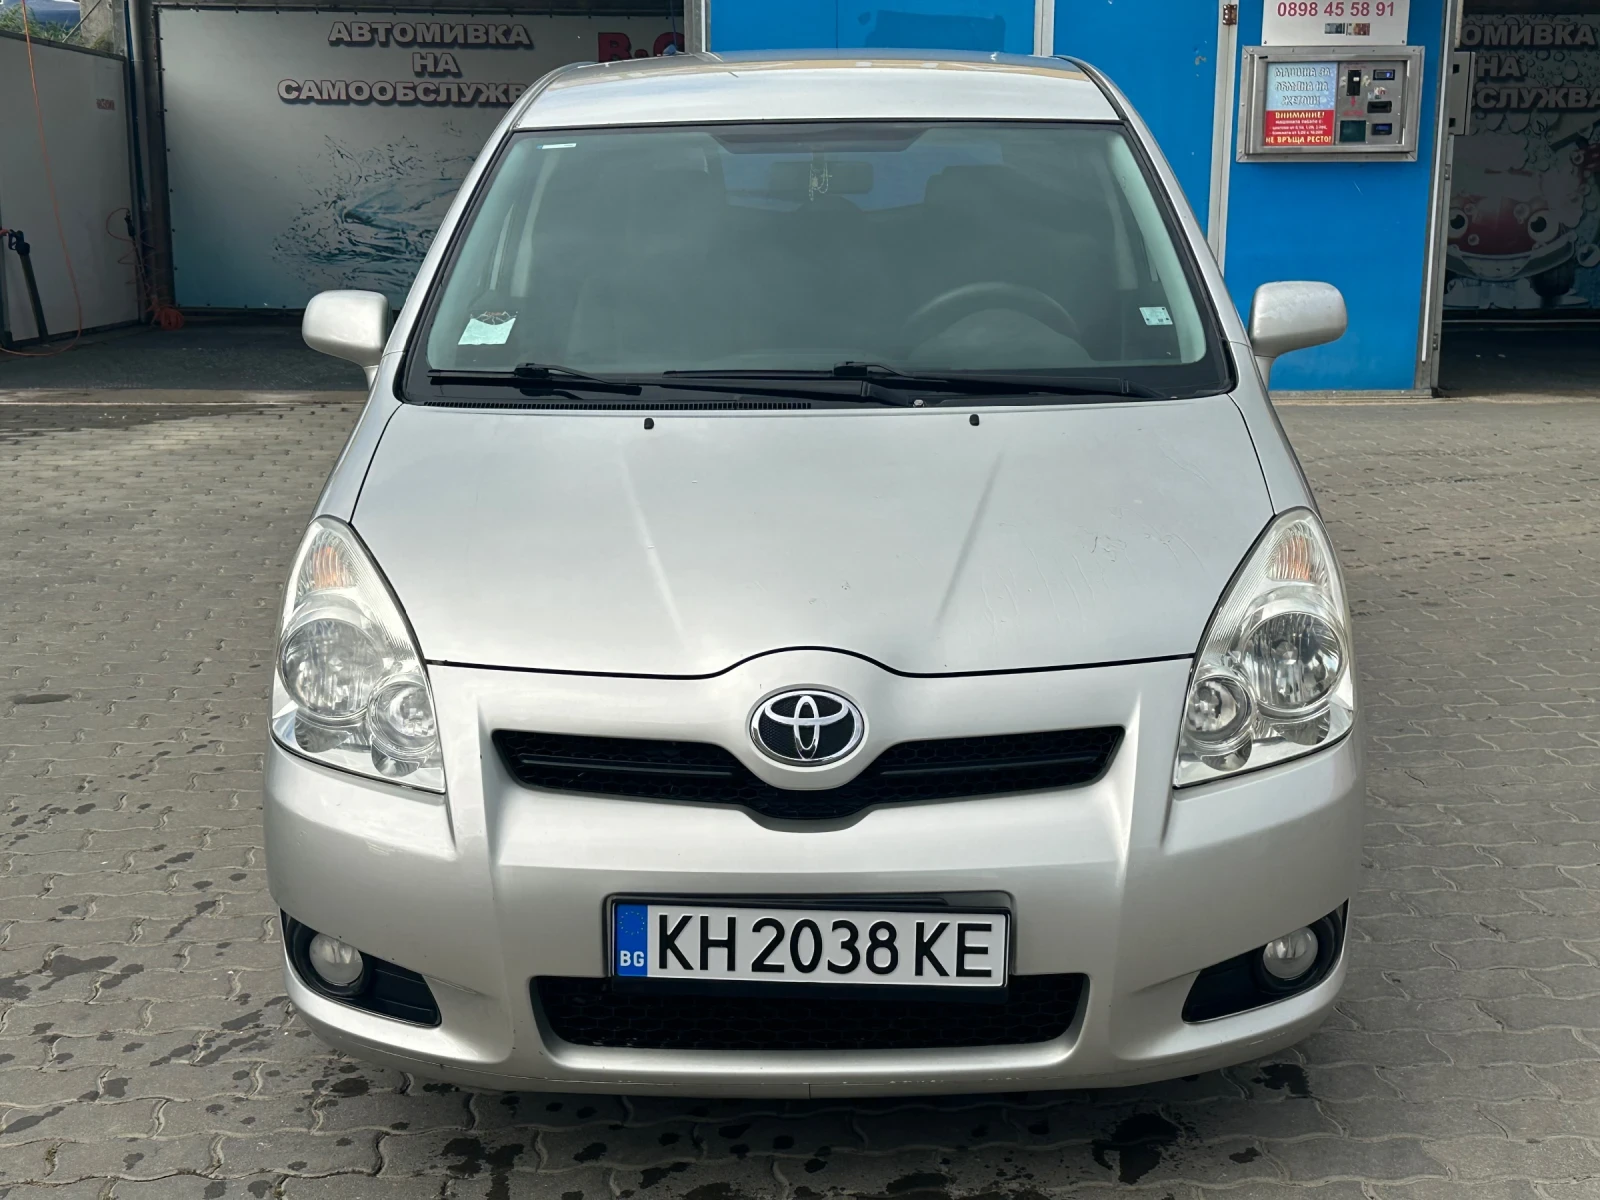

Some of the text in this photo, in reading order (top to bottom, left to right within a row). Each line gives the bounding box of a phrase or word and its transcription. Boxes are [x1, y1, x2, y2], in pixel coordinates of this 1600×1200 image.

[1277, 2, 1395, 17] 0898 45 58 91
[328, 21, 533, 48] АВТОМИВКА
[411, 52, 460, 75] НА
[1477, 56, 1522, 78] НА
[1275, 111, 1325, 119] ВНИМАНИЕ!
[1265, 135, 1332, 145] НЕ ВРЪЩА РЕСТО!
[658, 914, 994, 978] KH 2038 KE
[619, 950, 645, 968] BG
